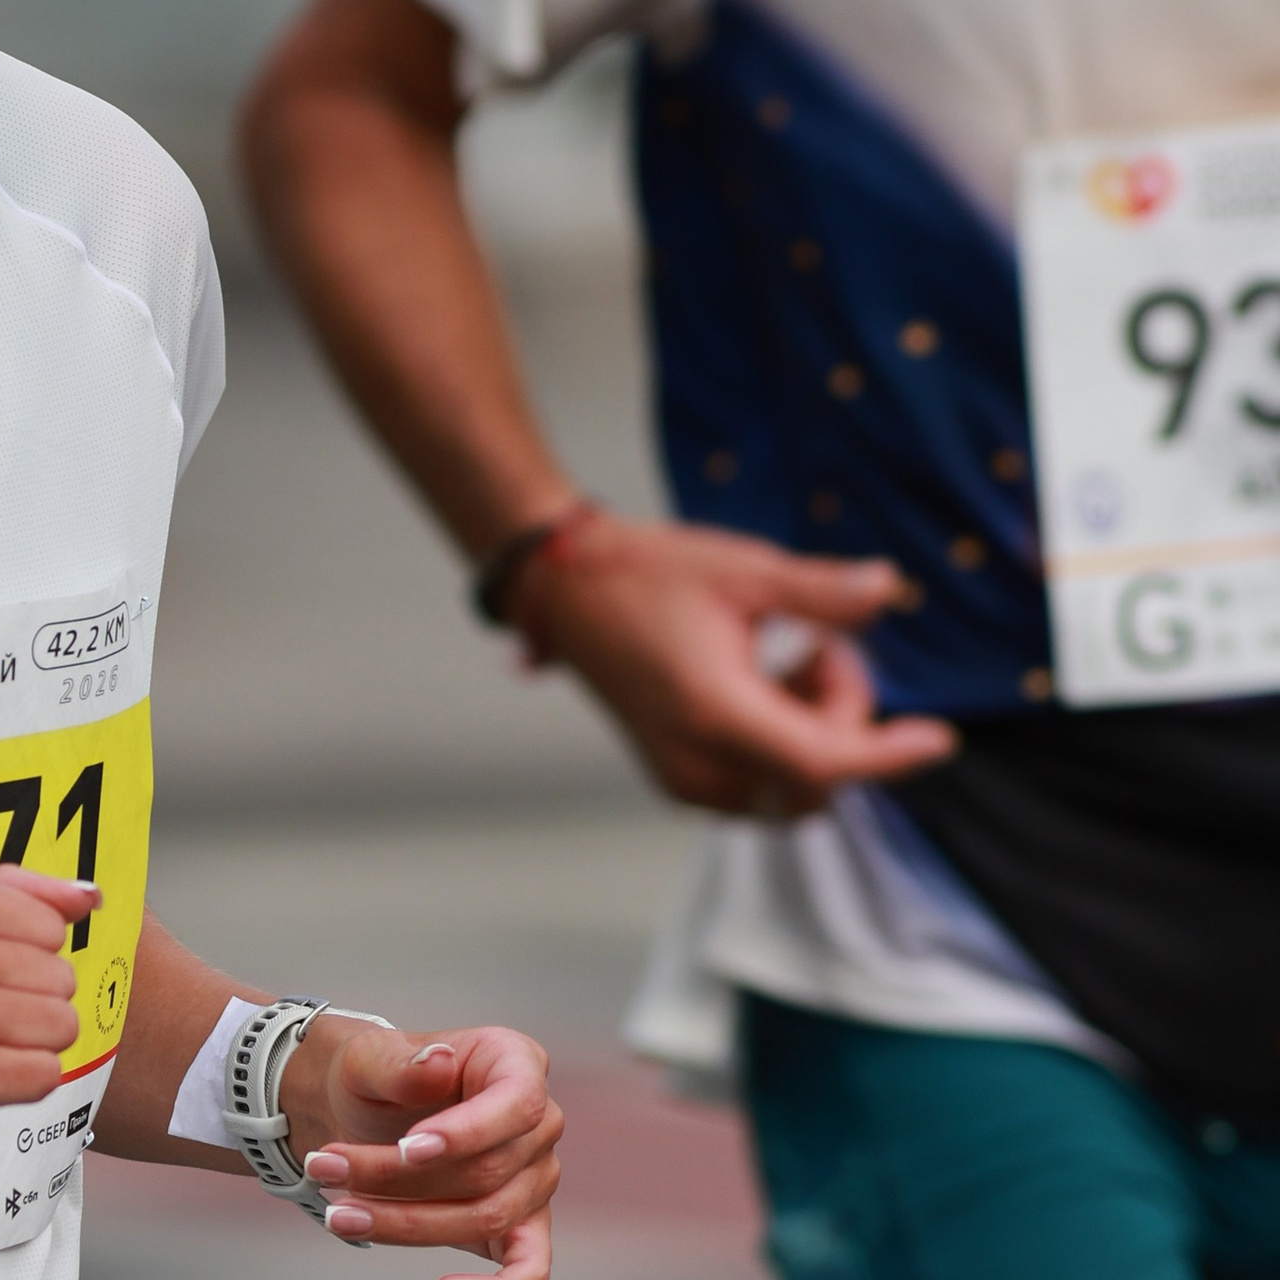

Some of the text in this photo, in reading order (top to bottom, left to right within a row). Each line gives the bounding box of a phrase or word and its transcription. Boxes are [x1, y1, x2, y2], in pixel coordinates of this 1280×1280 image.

[46, 625, 100, 659] 42,2
[58, 664, 119, 705] 2026
[107, 980, 117, 1010] 1
[37, 1120, 66, 1145] СБЕР
